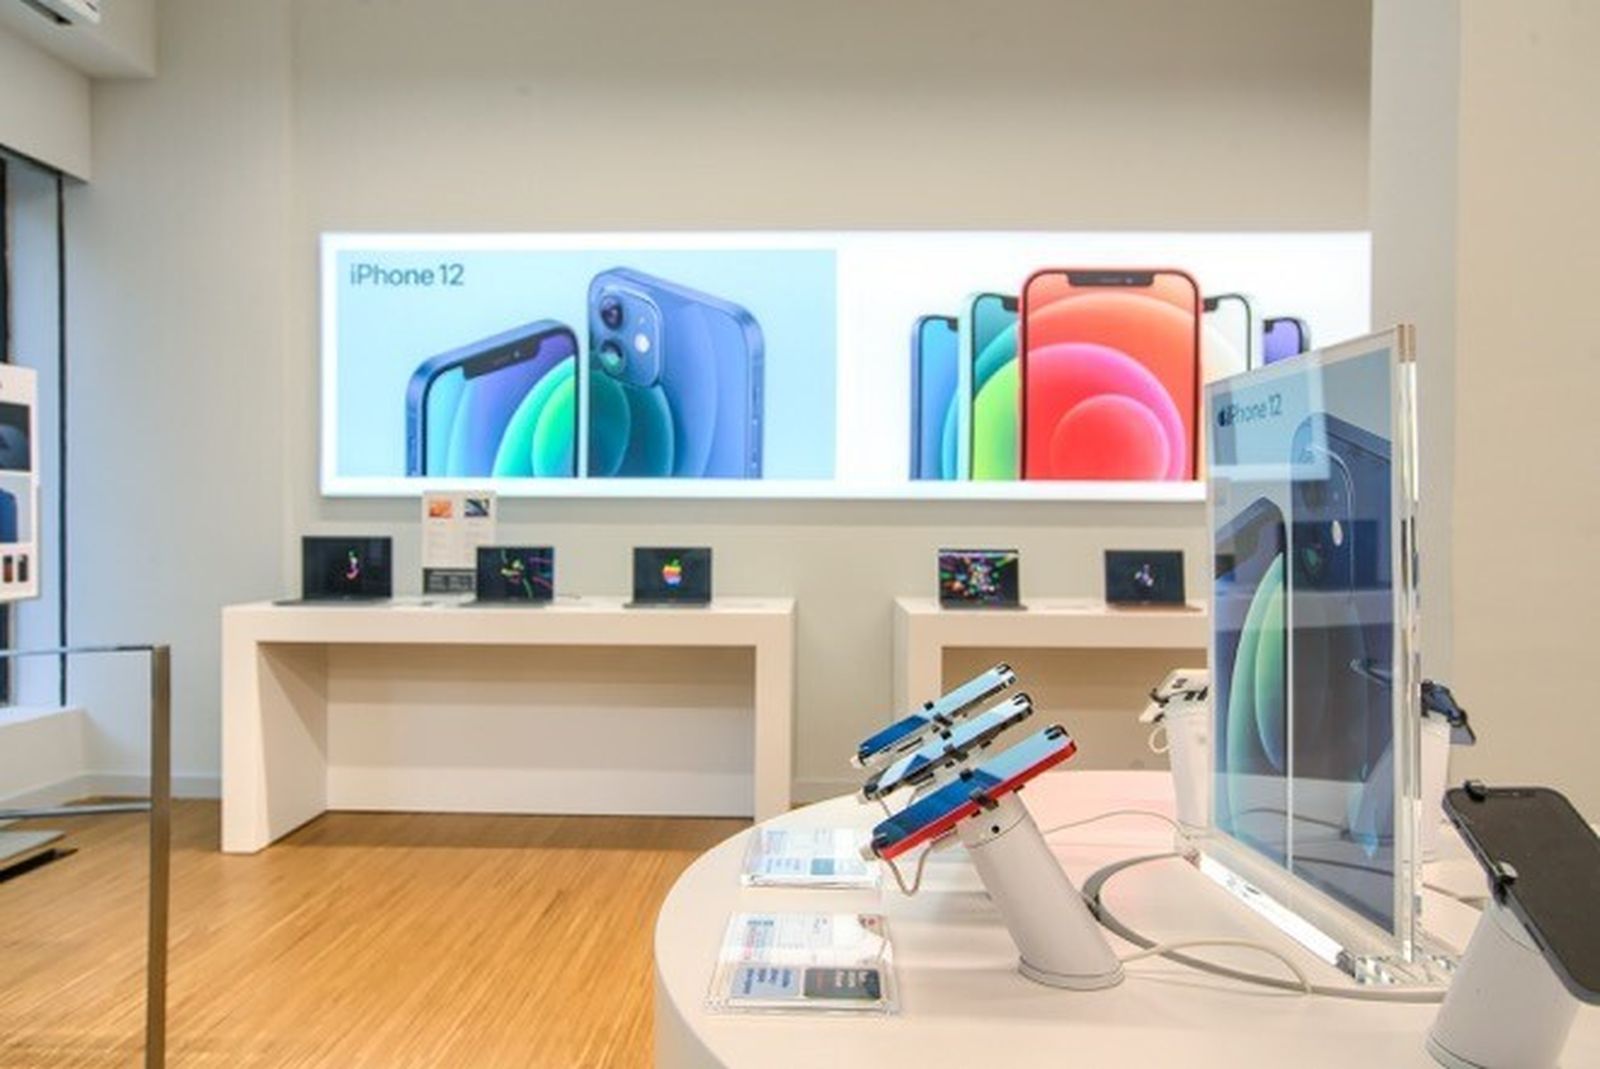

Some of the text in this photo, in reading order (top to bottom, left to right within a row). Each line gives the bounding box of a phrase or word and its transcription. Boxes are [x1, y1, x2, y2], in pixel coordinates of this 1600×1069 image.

[350, 263, 465, 286] iPhone 12
[1268, 393, 1282, 416] 12
